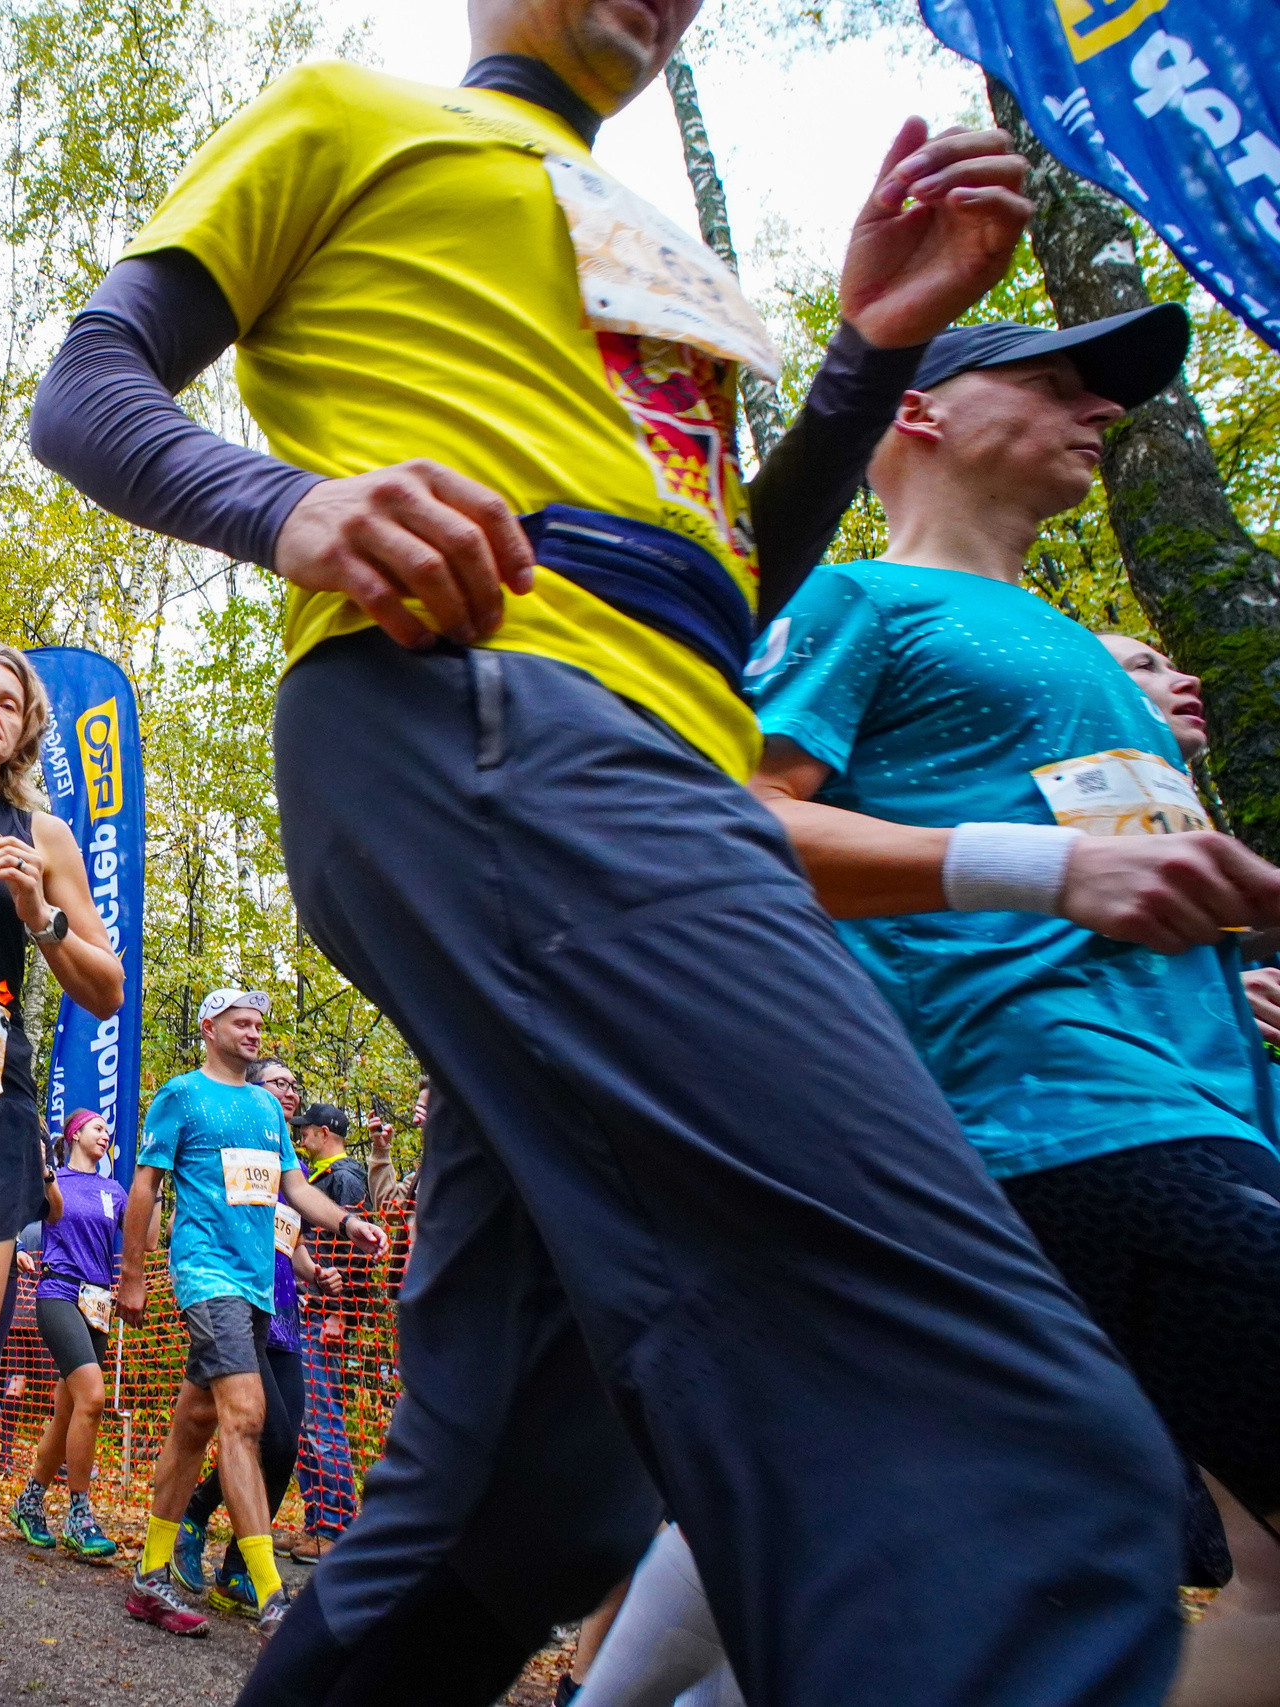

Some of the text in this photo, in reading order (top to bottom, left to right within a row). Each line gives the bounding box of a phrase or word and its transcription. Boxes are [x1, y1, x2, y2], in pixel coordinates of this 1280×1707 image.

[245, 1167, 270, 1182] 109
[274, 1216, 292, 1236] 176
[96, 1301, 106, 1314] 80
